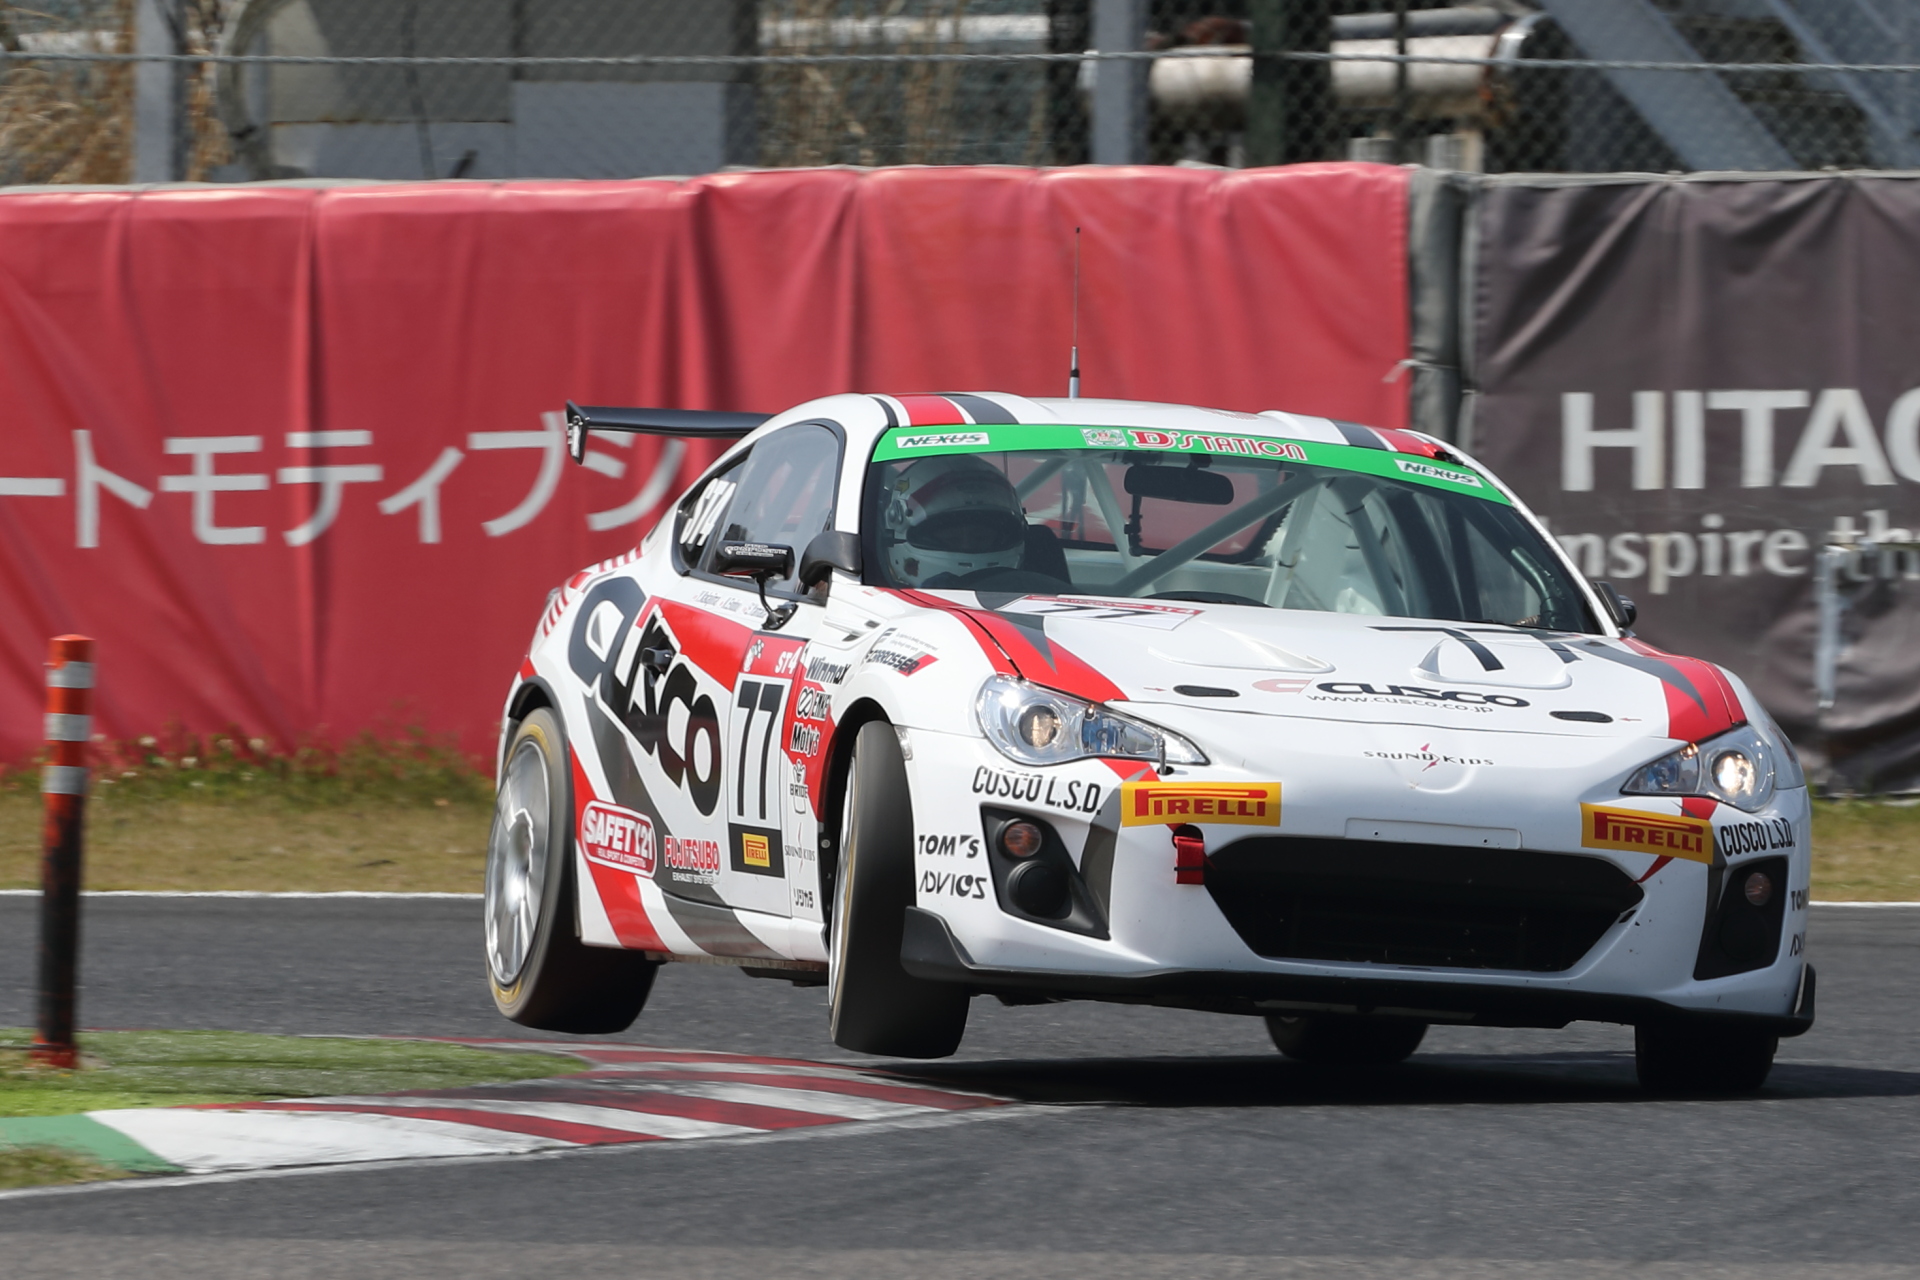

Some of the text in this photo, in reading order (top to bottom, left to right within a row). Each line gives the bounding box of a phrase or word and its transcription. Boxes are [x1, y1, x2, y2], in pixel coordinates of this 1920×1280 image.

[902, 433, 983, 447] NEXUS
[1128, 430, 1308, 461] D'STATION
[1404, 462, 1475, 484] NEXUS
[1538, 509, 1920, 595] nspire th
[1364, 626, 1584, 671] 77
[1307, 694, 1495, 714] www.cusco.co.jp
[737, 680, 785, 821] 77
[1363, 750, 1495, 766] SOUND KIDS
[789, 783, 808, 799] BRIDE
[972, 765, 1045, 802] CUSCO
[1134, 787, 1269, 818] PIRELLI
[918, 834, 980, 860] TOM'S
[1593, 810, 1705, 854] PIRELLI
[1719, 824, 1767, 857] CUSCO
[664, 836, 721, 873] FUJITSUBO
[745, 839, 767, 860] PIRELLI
